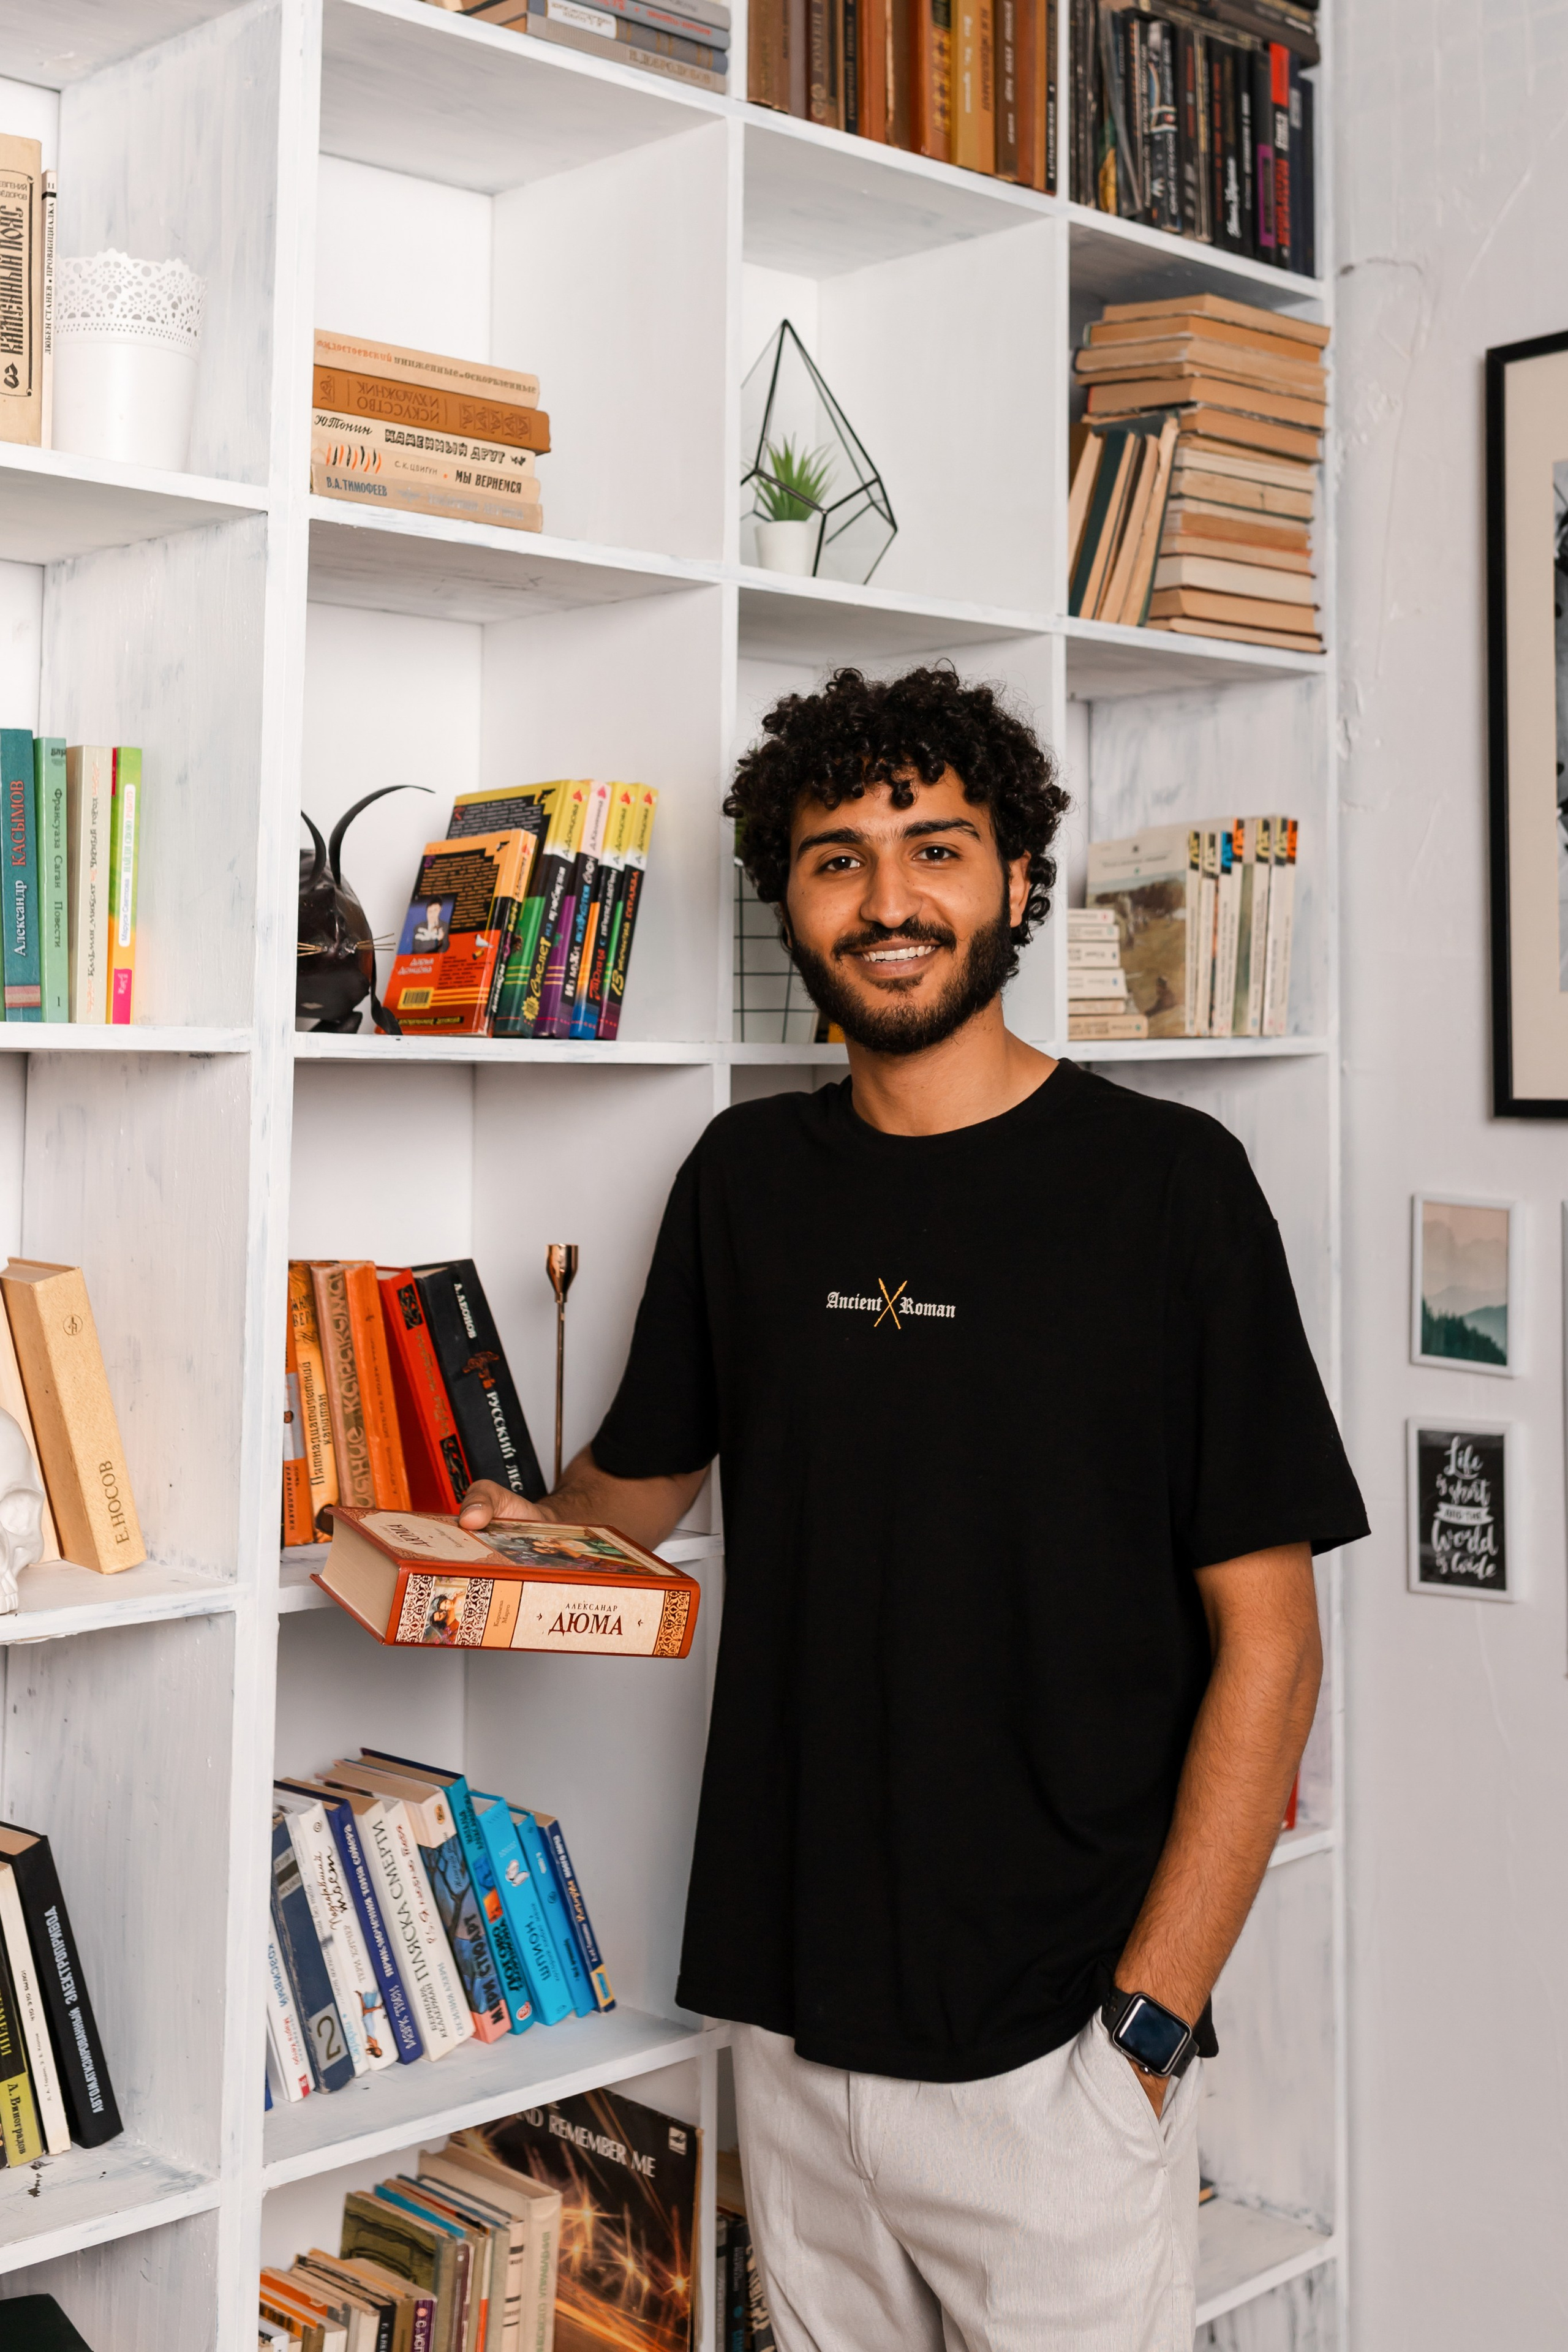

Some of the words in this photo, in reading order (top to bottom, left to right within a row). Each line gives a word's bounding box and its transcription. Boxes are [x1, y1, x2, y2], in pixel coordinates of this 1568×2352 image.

[45, 202, 55, 277] ПРОВИНЦИАЛКА
[356, 396, 440, 424] ИСКУССТВО
[384, 428, 467, 457] КАМЕННЫЙ
[470, 446, 505, 464] ДРУГ
[342, 478, 388, 497] ТИМОФЕЕВ
[454, 469, 471, 486] МЫ
[475, 472, 522, 494] ВЕРНЕМСЯ
[9, 779, 26, 867] КАСЫМОВ
[52, 788, 62, 849] Франсуаза
[13, 879, 26, 956] Александр
[53, 901, 62, 948] Повести
[529, 937, 551, 997] Скелет
[565, 803, 579, 846] Донцова
[826, 1291, 883, 1312] Ancient
[899, 1297, 956, 1318] Roman
[298, 1360, 324, 1486] Пятнадцатилетний
[317, 1392, 332, 1446] капитан
[485, 1390, 517, 1460] РУССКИЙ
[504, 1462, 524, 1494] ЛЕС
[1443, 1435, 1483, 1480] Life
[1449, 1478, 1492, 1507] short
[493, 1600, 503, 1627] Королева
[501, 1604, 511, 1624] Марго
[548, 1611, 624, 1637] ДЮМА
[565, 1602, 618, 1612] АЛЕКСАНДР
[368, 1818, 407, 1901] СМЕРТИ
[42, 1904, 79, 2005] ЭЛЕКТРОПРИВОД
[393, 1901, 431, 1983] ПЛЯСКА
[461, 1912, 494, 1977] СТЮАРТ
[480, 1977, 506, 2025] МЕРИ
[67, 2006, 104, 2114] АВТОМАТИЗИРОВАННЫЙ
[317, 2014, 341, 2060] 2
[7, 2082, 19, 2096] А.
[6, 2095, 30, 2155] Виноградов
[548, 2114, 627, 2165] REMEMBER
[630, 2150, 655, 2178] ME
